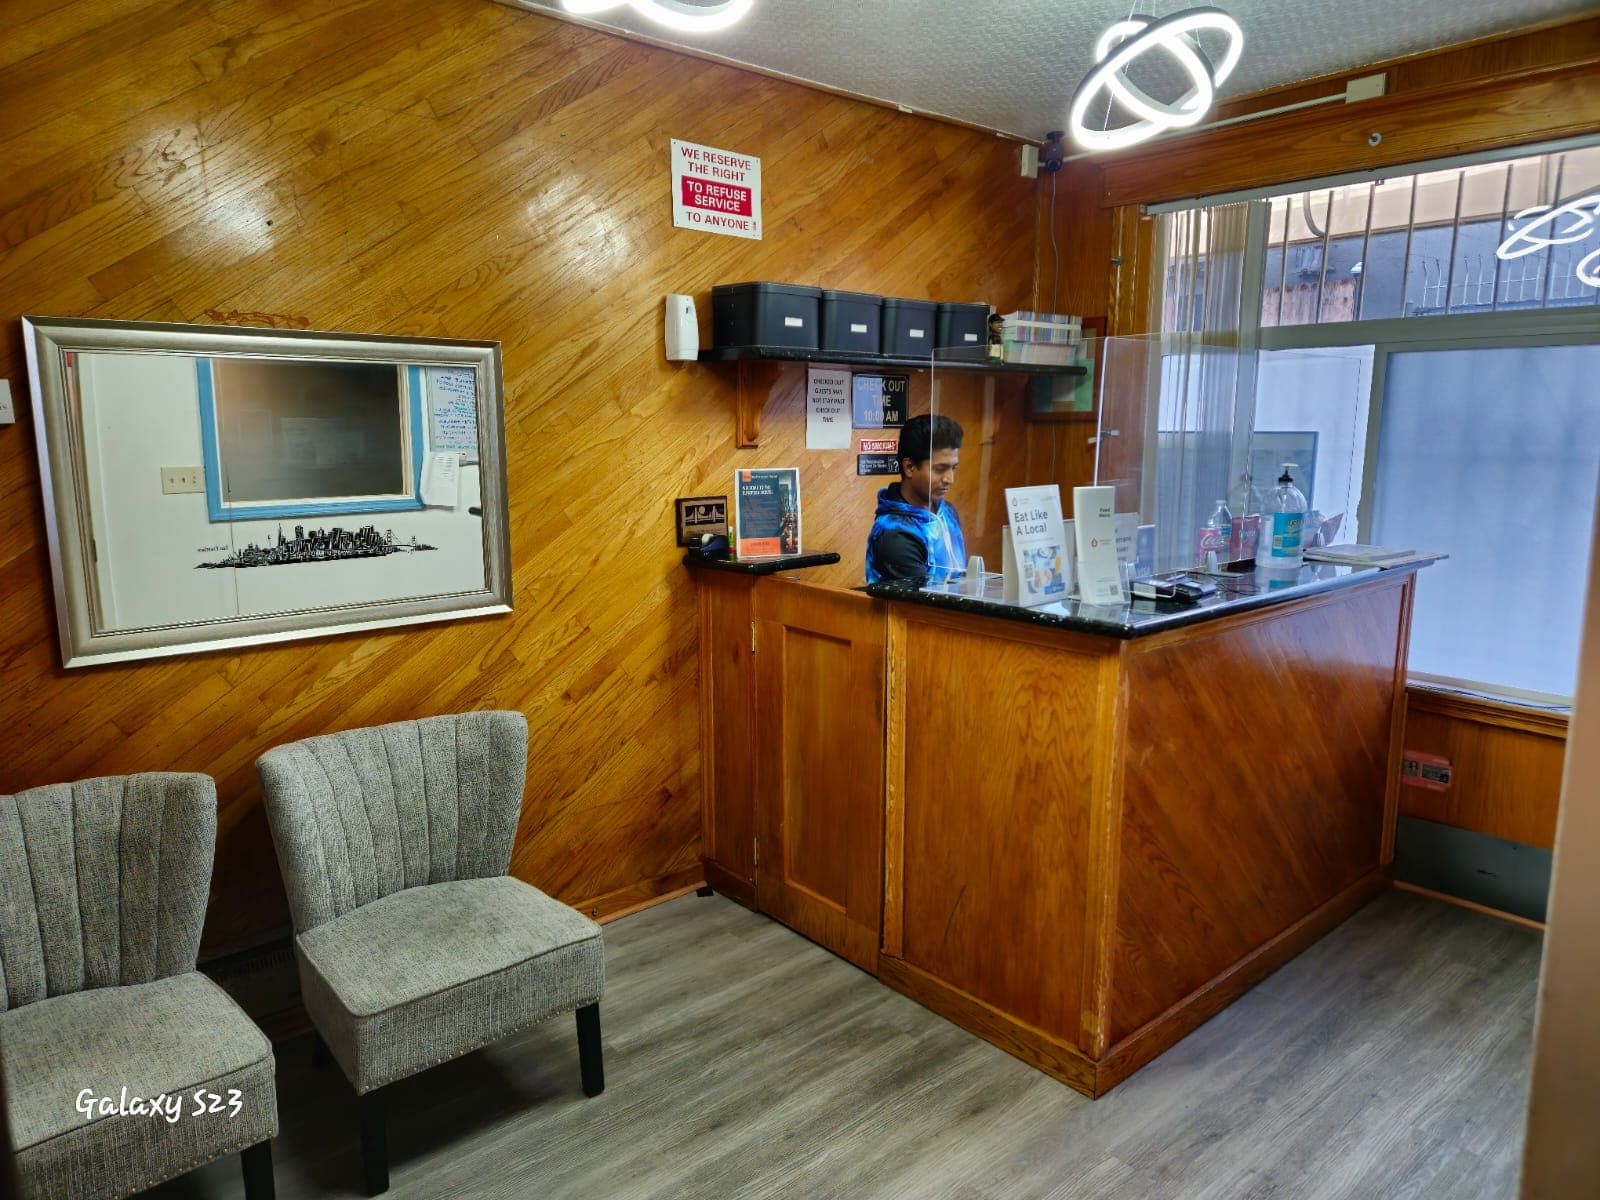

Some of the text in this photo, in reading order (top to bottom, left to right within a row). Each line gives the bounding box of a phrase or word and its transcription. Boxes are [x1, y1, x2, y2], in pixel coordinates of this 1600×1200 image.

[681, 147, 751, 170] WE RESERVE
[688, 161, 745, 182] THE RIGHT
[686, 180, 747, 201] TO REFUSE
[694, 194, 740, 211] SERVICE
[686, 211, 701, 223] TO
[704, 215, 749, 231] ANYONE
[888, 380, 906, 393] OUT
[886, 410, 899, 422] AM
[1014, 509, 1049, 523] Eat Like
[1016, 522, 1047, 536] A Local
